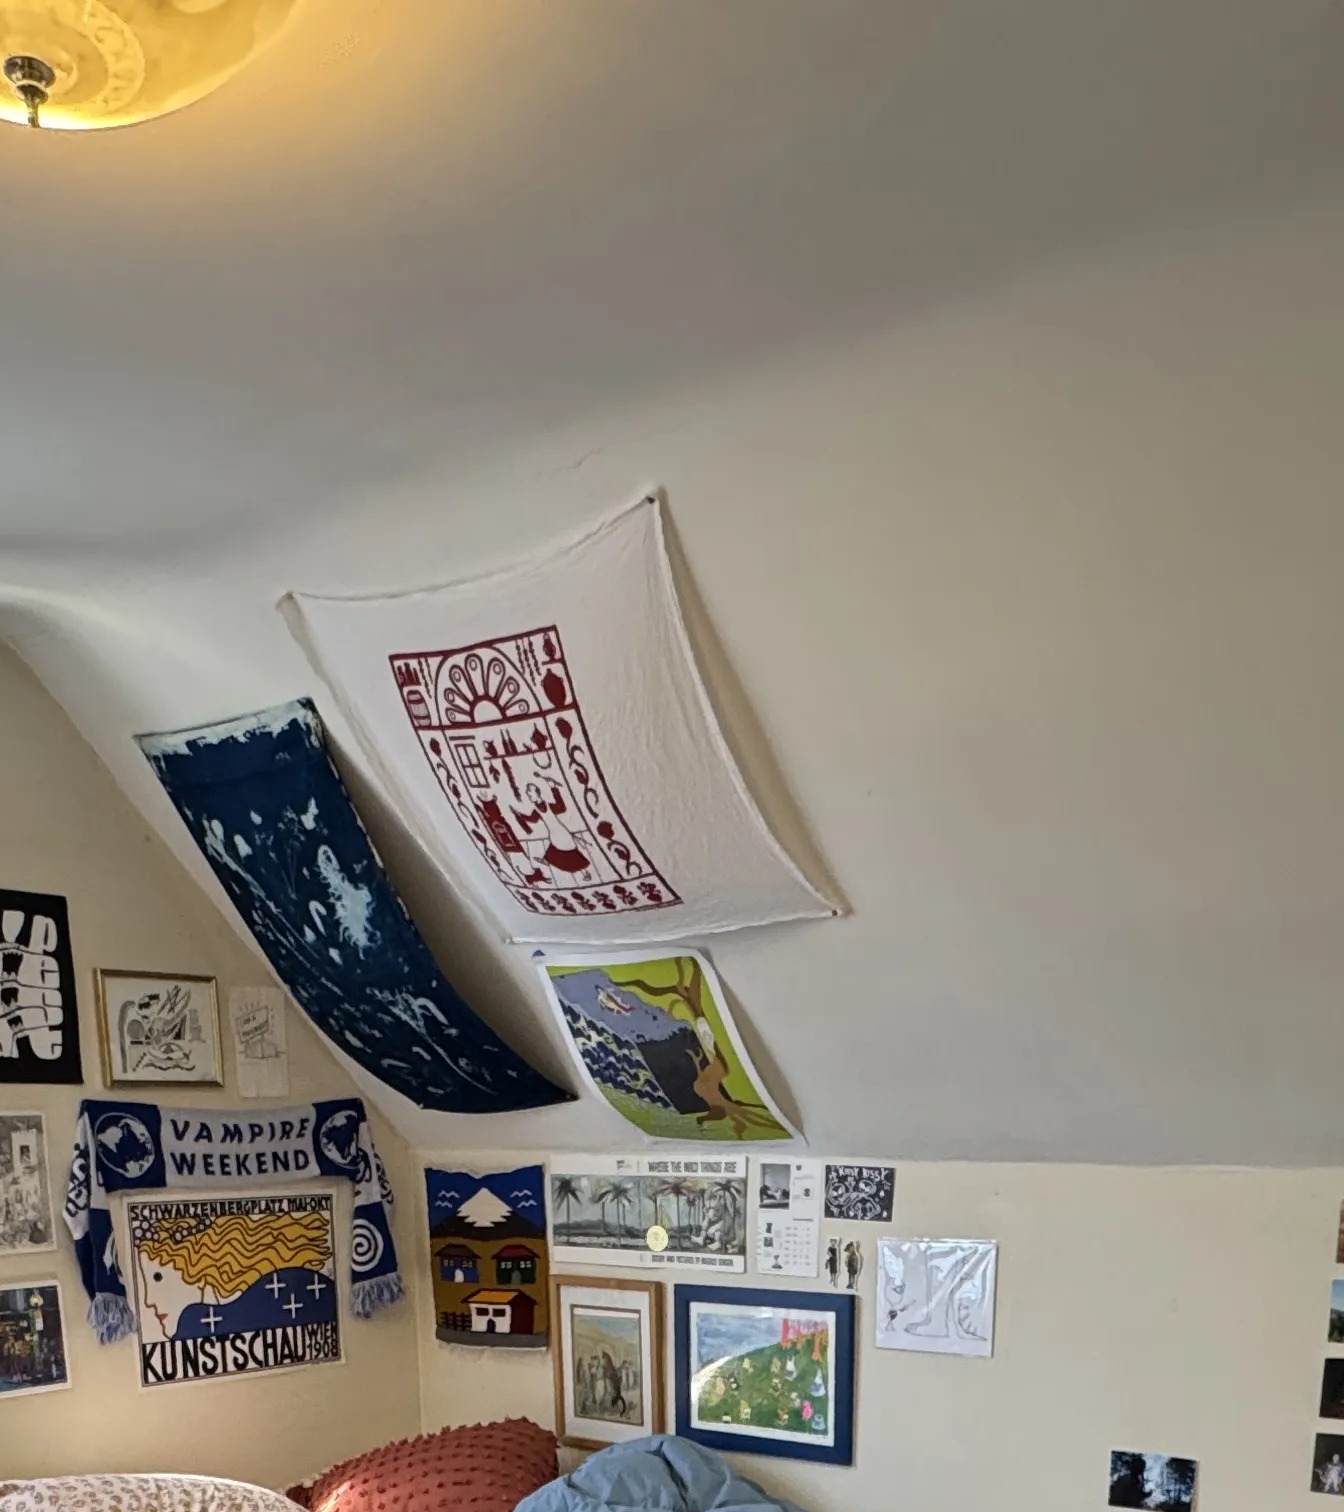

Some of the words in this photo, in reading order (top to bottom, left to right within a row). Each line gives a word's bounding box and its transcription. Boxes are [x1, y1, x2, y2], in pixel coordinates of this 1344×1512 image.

[169, 1117, 311, 1144] VAMPIRE
[169, 1149, 311, 1177] WEEKEND
[306, 1321, 337, 1342] WIEN
[142, 1325, 307, 1384] KUNSTSCHAU
[306, 1339, 339, 1361] 1908
